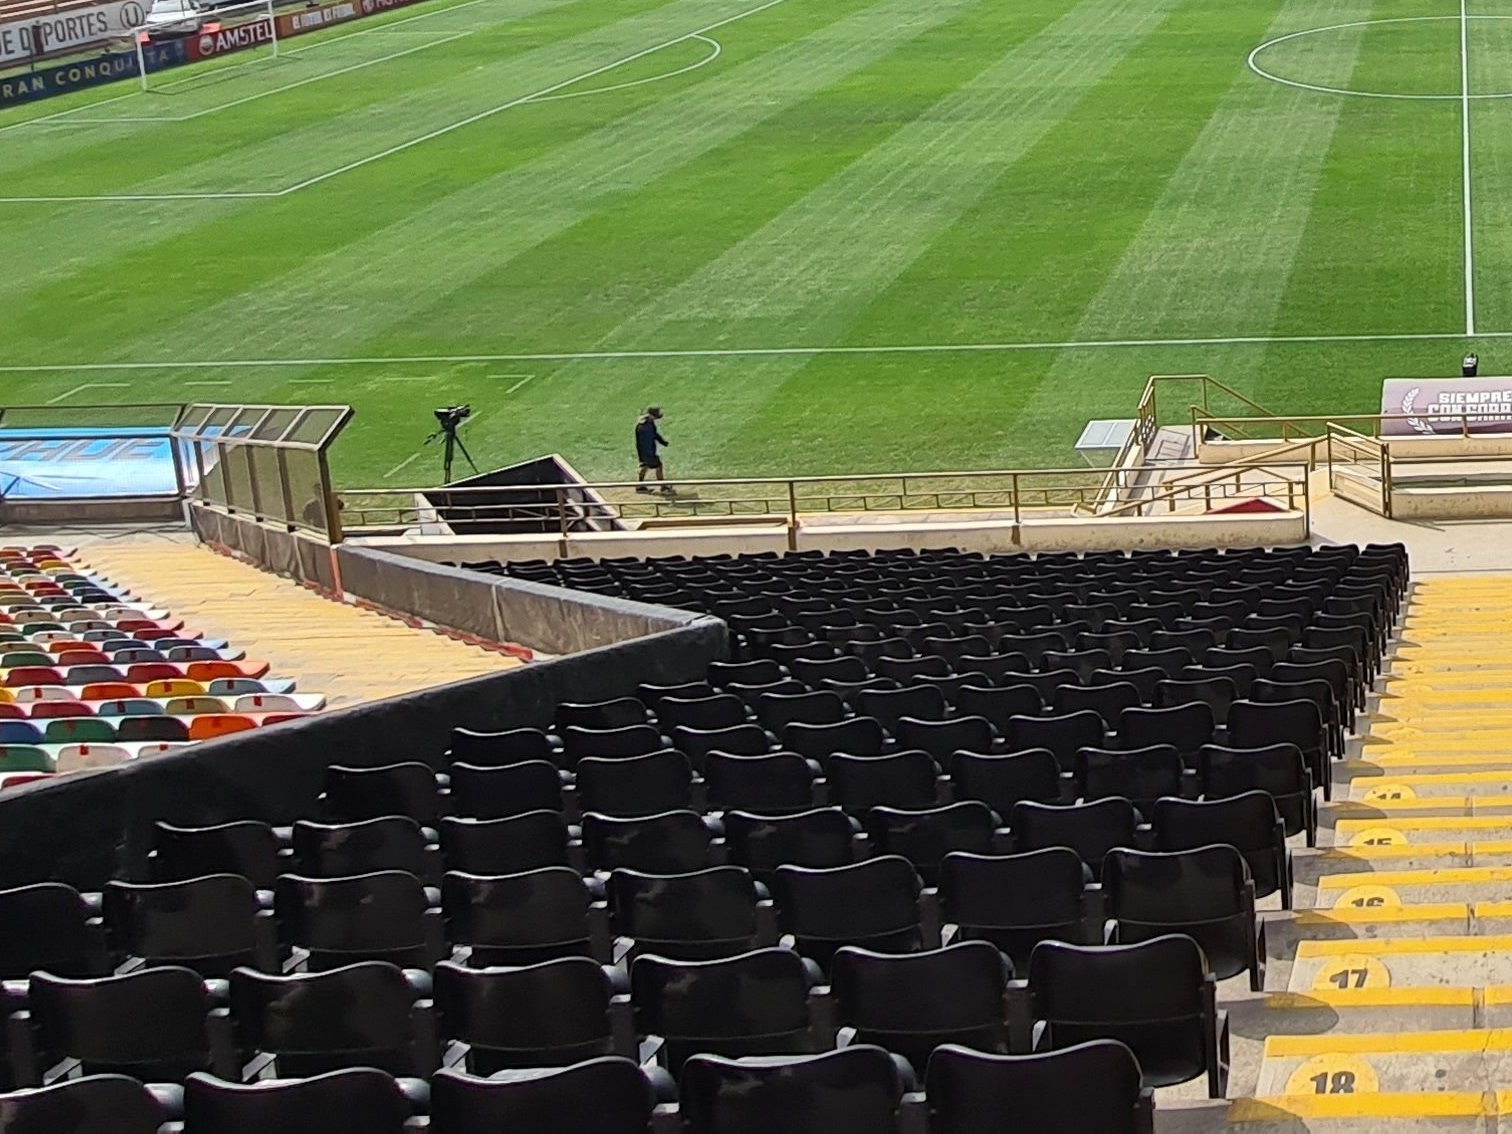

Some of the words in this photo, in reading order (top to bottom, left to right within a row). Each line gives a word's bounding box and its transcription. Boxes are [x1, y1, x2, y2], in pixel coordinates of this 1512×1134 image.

[0, 29, 15, 55] E
[19, 10, 108, 53] DPORTES
[215, 21, 273, 52] AMSTEL
[2, 75, 45, 99] RAN
[55, 51, 169, 86] CONQUITA
[1439, 391, 1512, 404] SIEMPRE
[1427, 403, 1463, 422] CON
[1329, 969, 1369, 988] 17
[1309, 1071, 1356, 1094] 18
